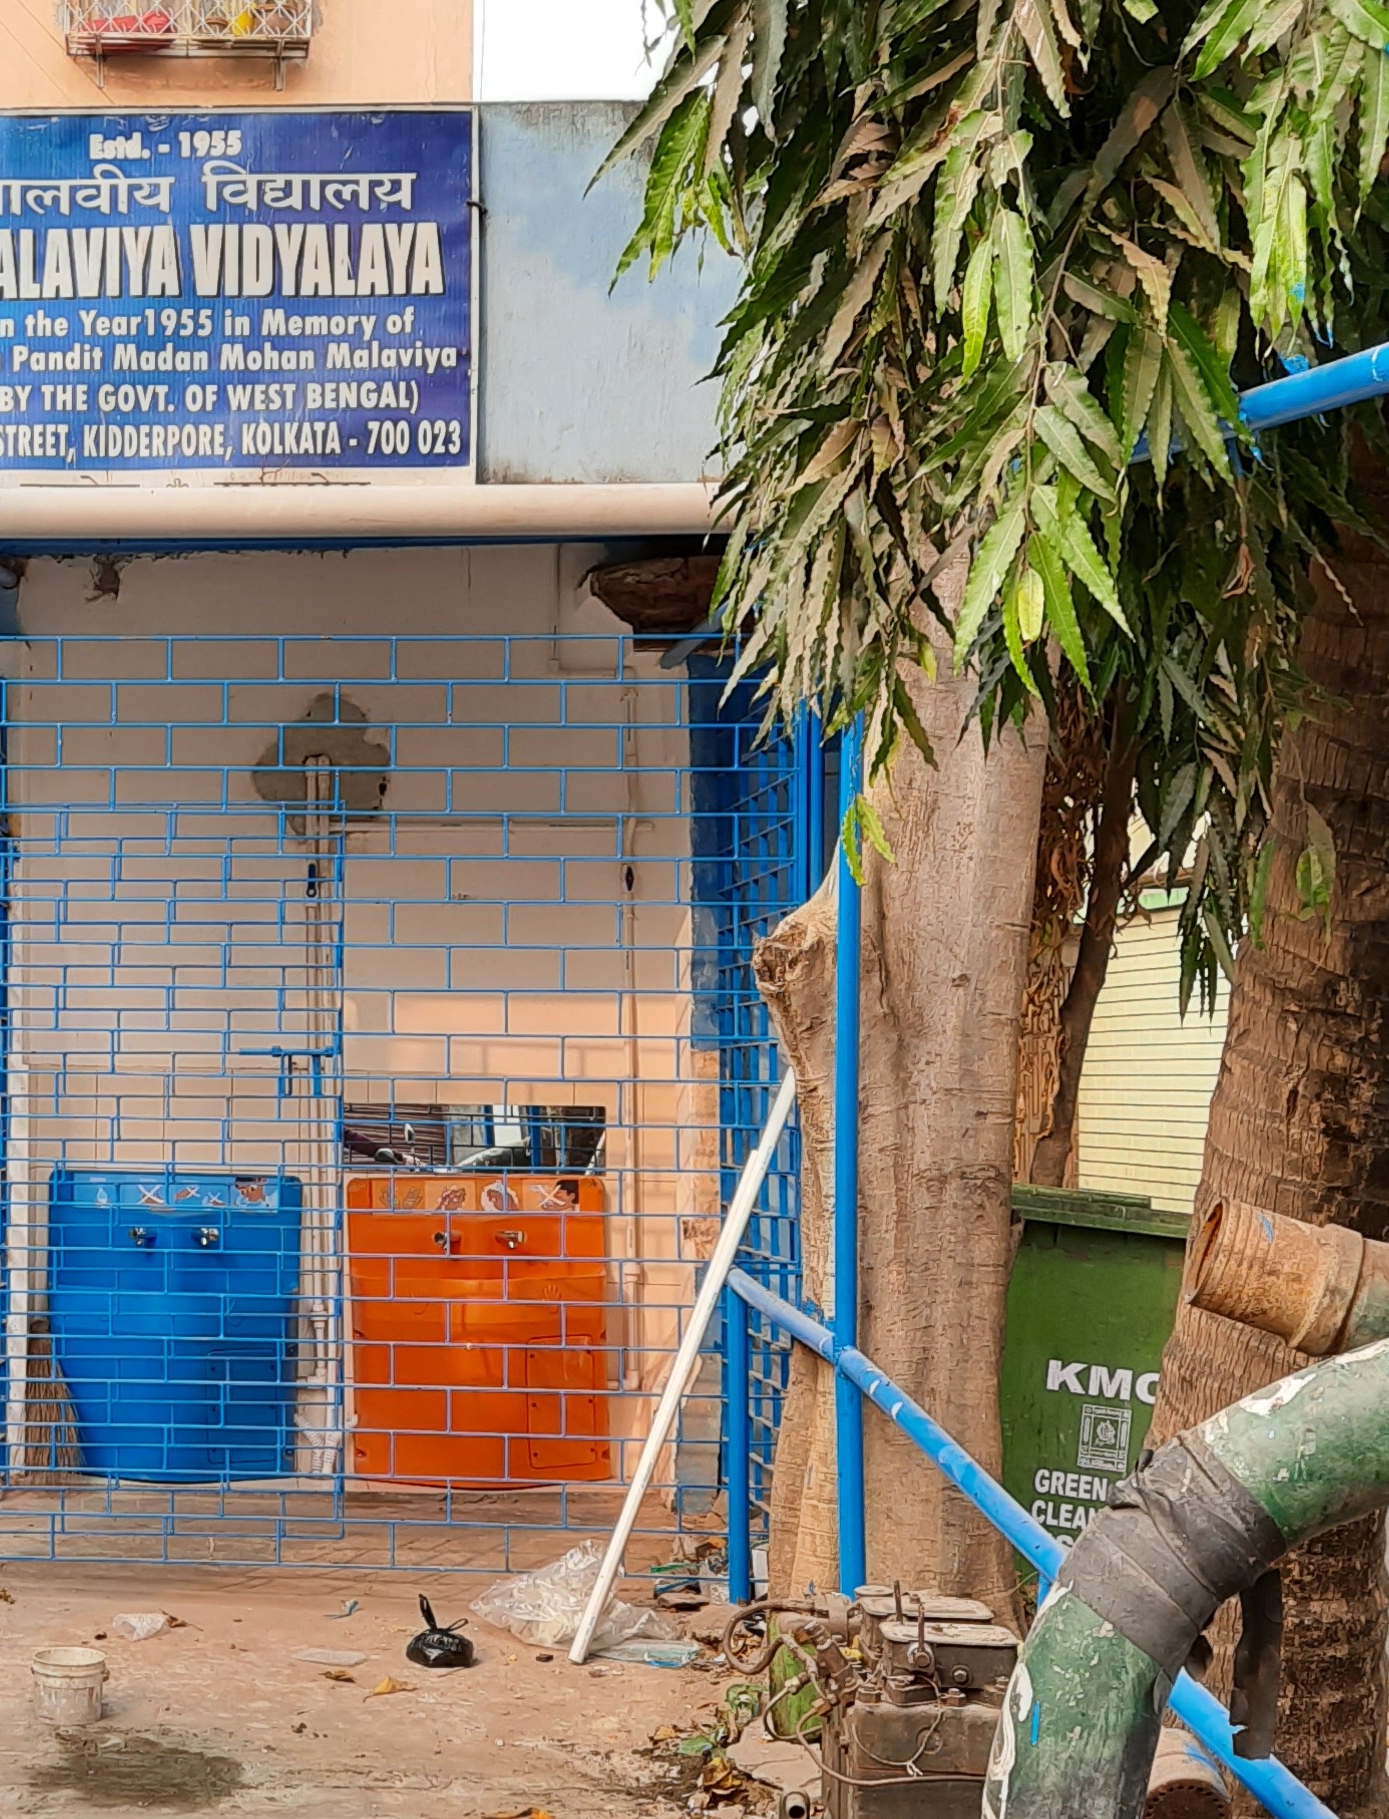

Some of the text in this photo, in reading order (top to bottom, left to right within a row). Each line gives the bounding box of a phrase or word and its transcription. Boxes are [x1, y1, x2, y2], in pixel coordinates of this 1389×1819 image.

[89, 133, 151, 160] Estd.
[178, 130, 242, 156] 1955
[202, 160, 417, 212] विद्यालय
[189, 222, 444, 297] VIDYALAYA
[24, 310, 69, 337] the
[224, 309, 250, 336] in
[262, 308, 377, 340] Memory
[386, 306, 415, 334] of
[13, 342, 103, 373] Pandit
[113, 343, 208, 371] Madan
[219, 342, 315, 371] Mohan
[326, 341, 457, 373] Malaviya
[41, 384, 88, 411] THE
[98, 384, 174, 413] GOVT.
[185, 384, 218, 412] OF
[226, 383, 297, 411] WEST
[306, 380, 419, 414] BENGAL)
[83, 423, 233, 461] KIDDERPORE,
[241, 421, 341, 456] KOLKATA
[367, 420, 410, 455] 700
[417, 420, 460, 454] 023
[1034, 1469, 1108, 1502] GREEN
